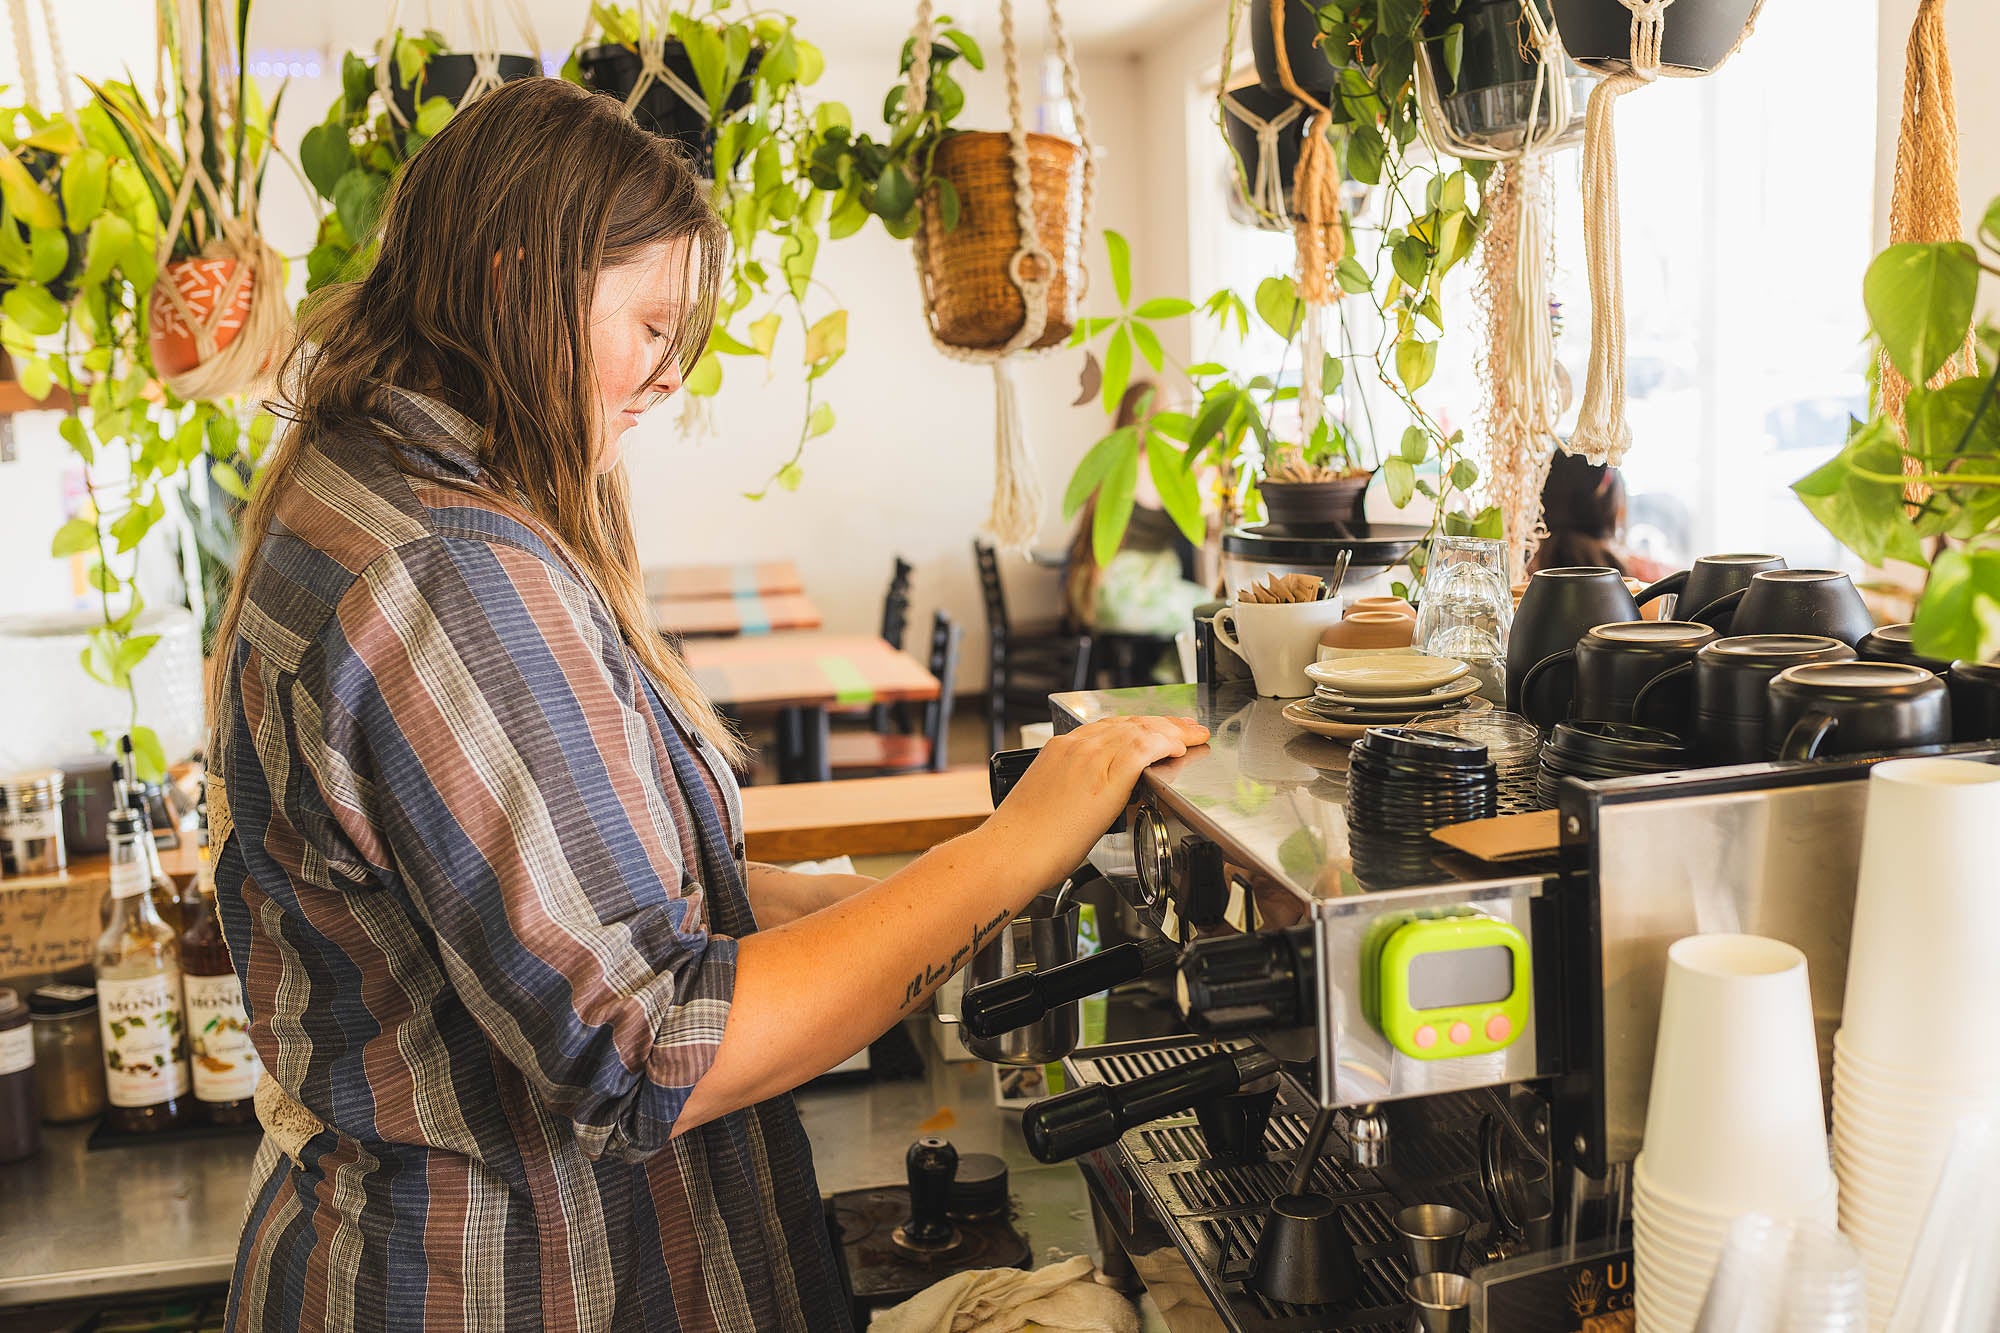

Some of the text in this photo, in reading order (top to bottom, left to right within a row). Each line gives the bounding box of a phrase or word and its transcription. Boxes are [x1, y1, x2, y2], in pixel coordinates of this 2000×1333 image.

[925, 963, 947, 986] love
[949, 945, 971, 976] you
[972, 908, 1010, 955] forever
